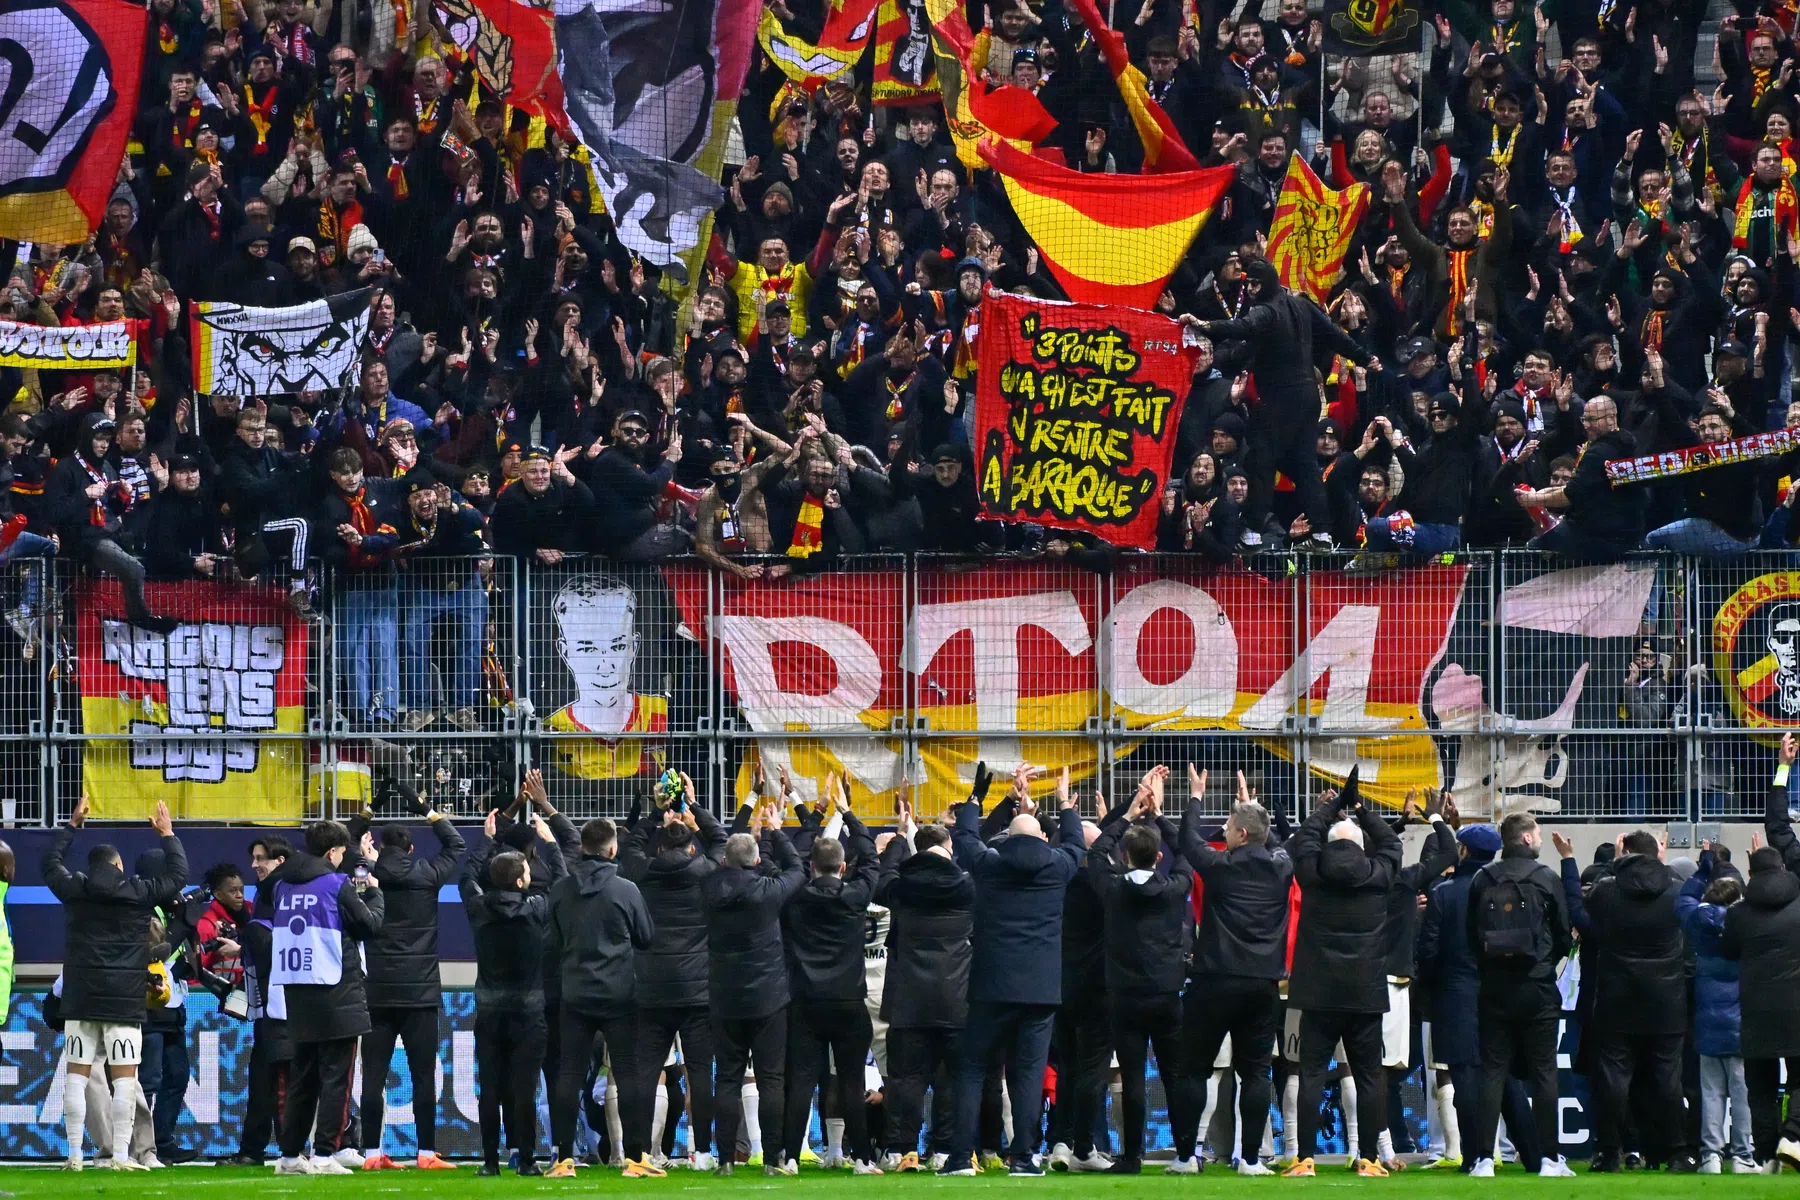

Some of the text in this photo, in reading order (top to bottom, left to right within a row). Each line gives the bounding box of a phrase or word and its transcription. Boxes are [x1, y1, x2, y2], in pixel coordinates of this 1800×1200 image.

[1143, 340, 1178, 355] RT94
[1031, 419, 1130, 467] RENTRE
[279, 894, 318, 910] LFP
[279, 947, 301, 972] 10
